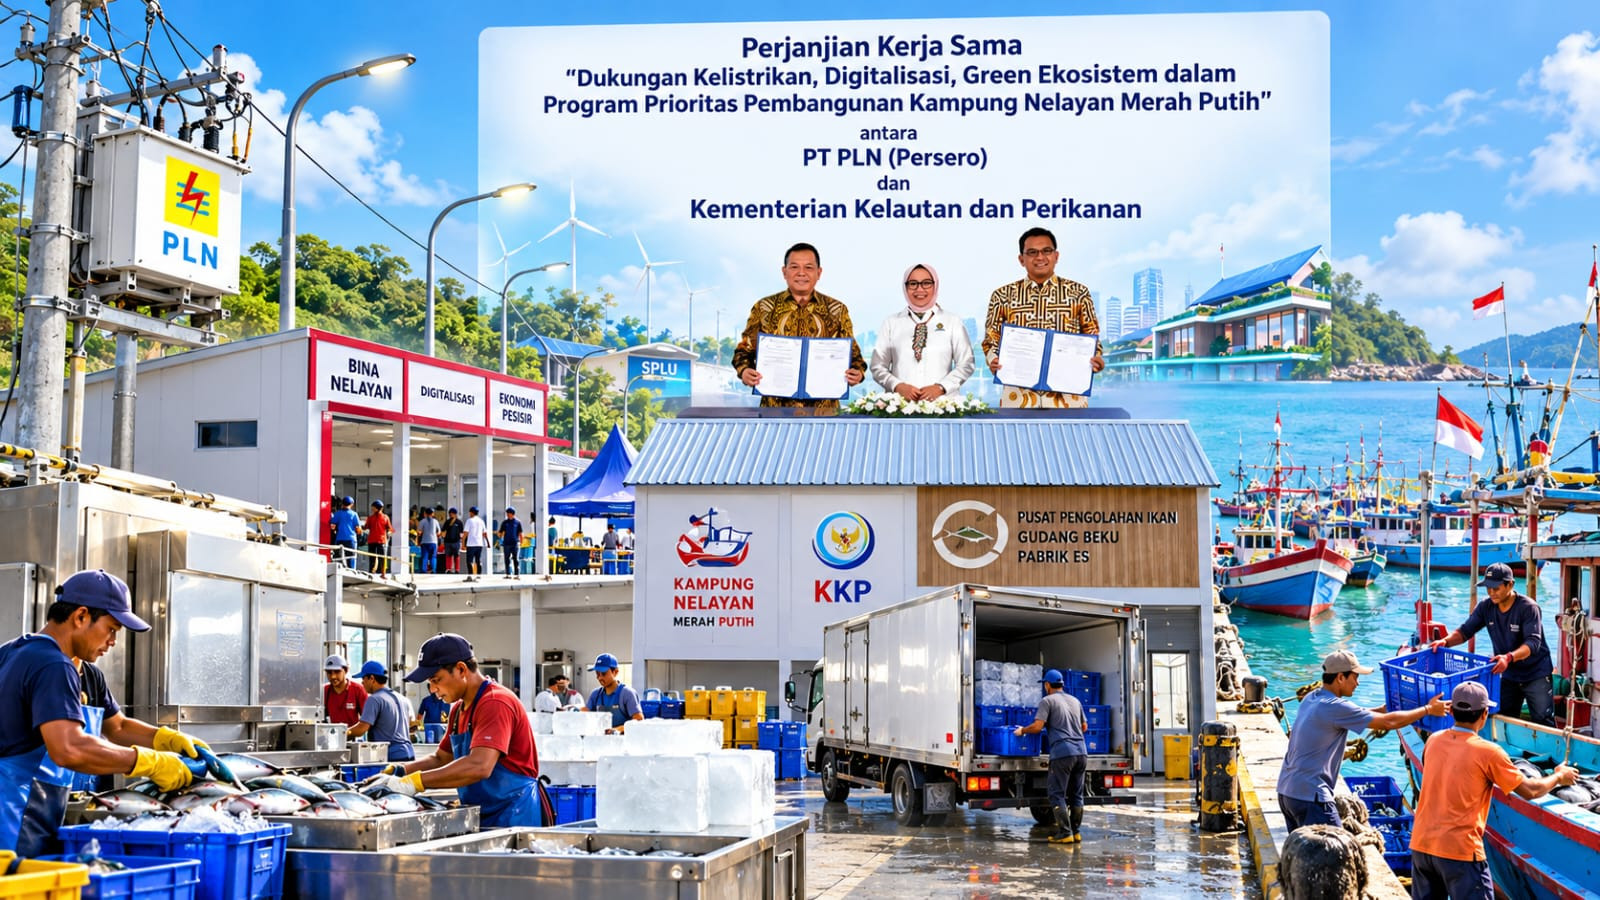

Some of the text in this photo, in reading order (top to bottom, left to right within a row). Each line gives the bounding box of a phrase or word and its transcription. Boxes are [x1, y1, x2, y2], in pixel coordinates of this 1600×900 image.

[163, 230, 218, 269] PLN
[349, 358, 379, 378] BINA
[641, 361, 678, 376] SPLU
[331, 374, 392, 400] NELAYAN
[421, 386, 474, 405] DIGITALISASI
[499, 392, 535, 410] EKONOMI
[502, 409, 532, 424] PESISIR
[1018, 511, 1176, 523] PUSAT PENGOLAHAN IKAN
[1018, 531, 1119, 543] GUDANG BEKU
[1018, 550, 1089, 563] PABRIK ES
[674, 578, 753, 590] KAMPUNG
[815, 580, 871, 602] KKP
[674, 596, 753, 610] NELAYAN
[674, 616, 754, 627] MERAH PUTIH
